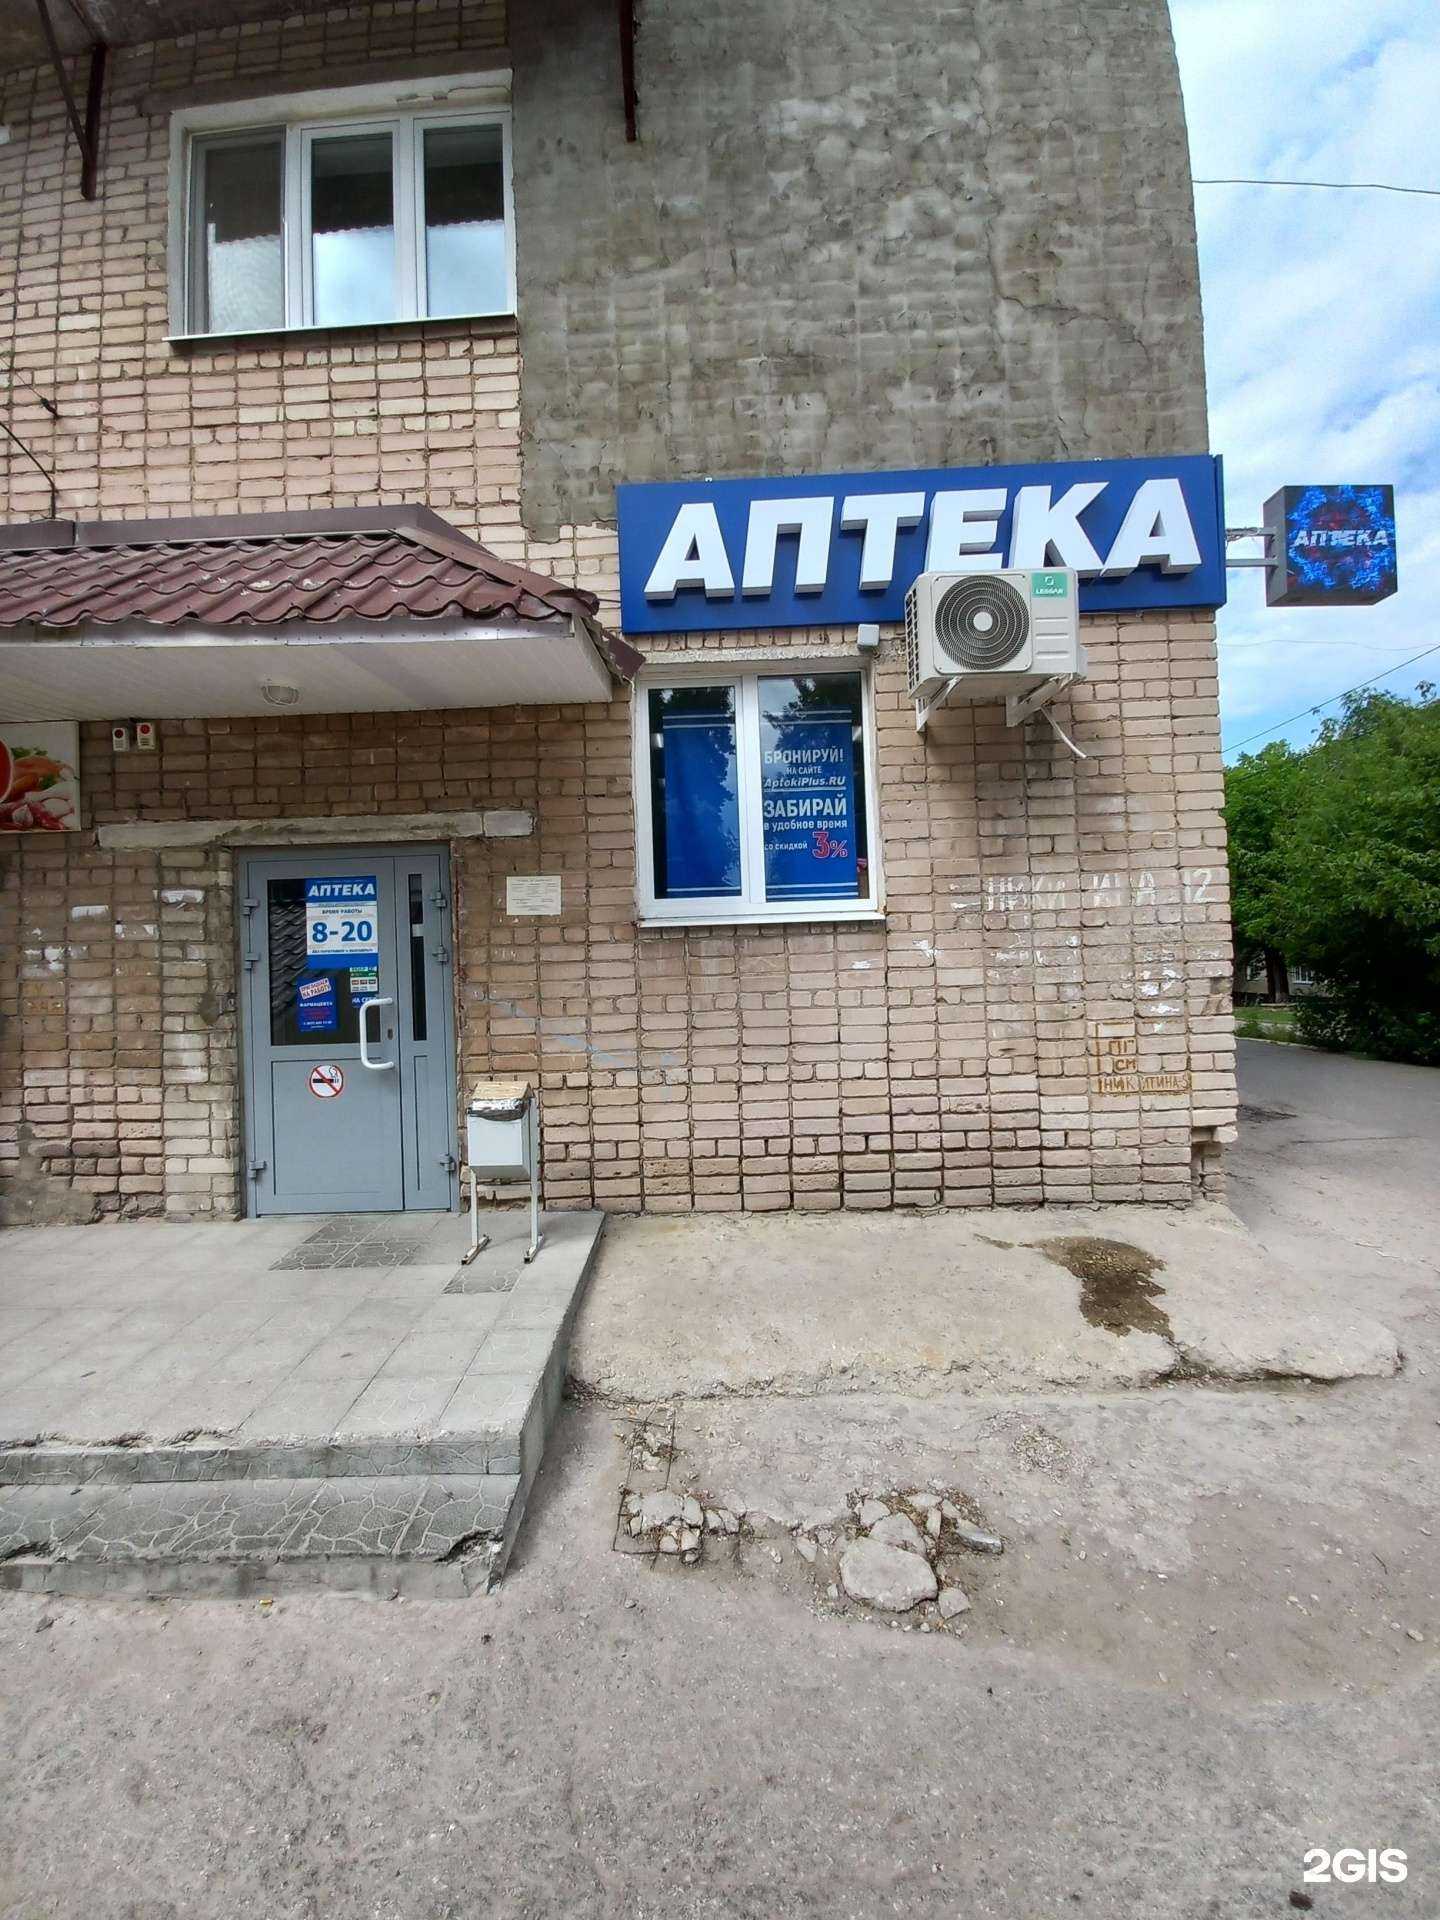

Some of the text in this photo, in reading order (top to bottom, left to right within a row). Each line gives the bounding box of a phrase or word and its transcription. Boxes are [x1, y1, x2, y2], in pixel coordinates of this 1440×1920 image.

[643, 478, 1202, 601] АПТЕКА
[1290, 529, 1389, 547] АПТЕКА
[764, 746, 844, 764] БРОНИРУЙ!
[799, 765, 822, 775] САЙТЕ
[764, 793, 847, 818] ЗАБИРАЙ
[772, 819, 815, 832] удобное
[817, 819, 848, 831] время
[775, 840, 808, 851] скидкой
[812, 831, 848, 859] 3%
[308, 883, 376, 897] АПТЕКА
[312, 920, 373, 943] 8-20
